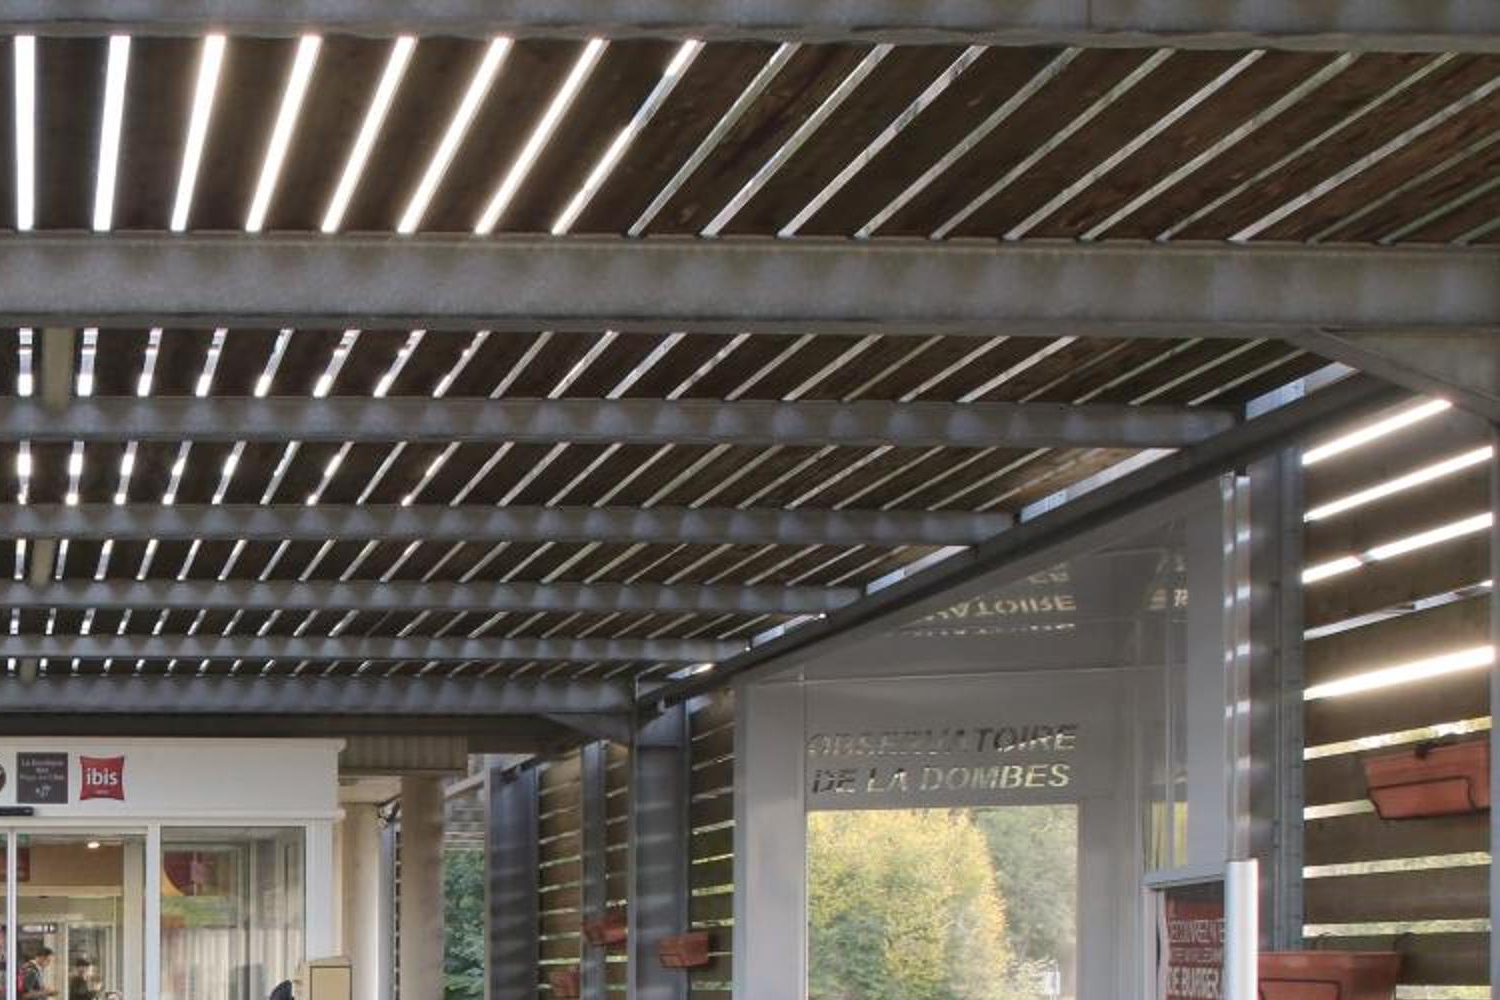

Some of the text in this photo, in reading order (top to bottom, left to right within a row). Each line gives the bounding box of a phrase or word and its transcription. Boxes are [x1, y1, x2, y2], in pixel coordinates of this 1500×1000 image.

[808, 726, 1078, 756] OBSERVATOIRE
[87, 767, 117, 785] ibis
[811, 762, 1071, 793] DE LA DOMBES
